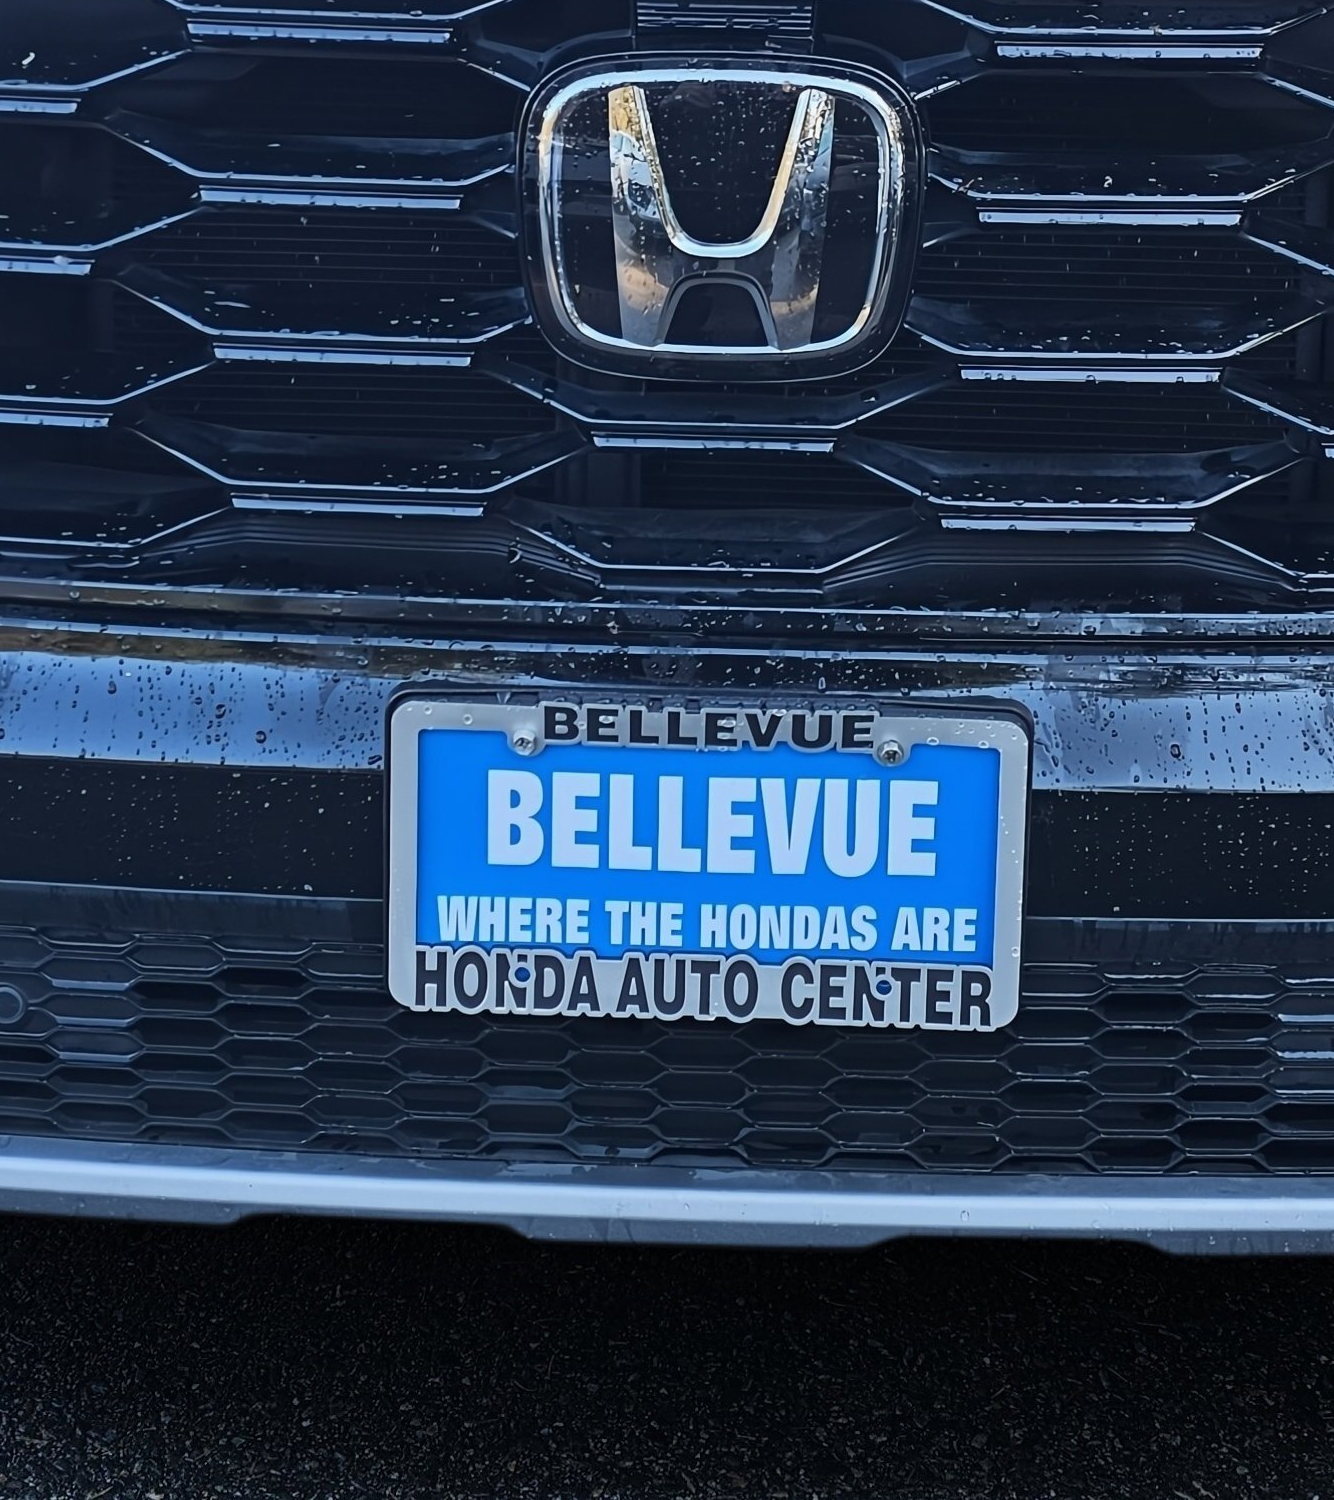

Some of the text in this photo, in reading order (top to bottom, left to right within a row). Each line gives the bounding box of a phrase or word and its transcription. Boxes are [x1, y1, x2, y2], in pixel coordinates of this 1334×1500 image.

[543, 704, 876, 750] BELLEVUE
[487, 769, 939, 877] BELLEVUE
[437, 895, 978, 953] WHERE THE HONDAS ARE
[414, 949, 993, 1028] HONDA AUTO CENTER
